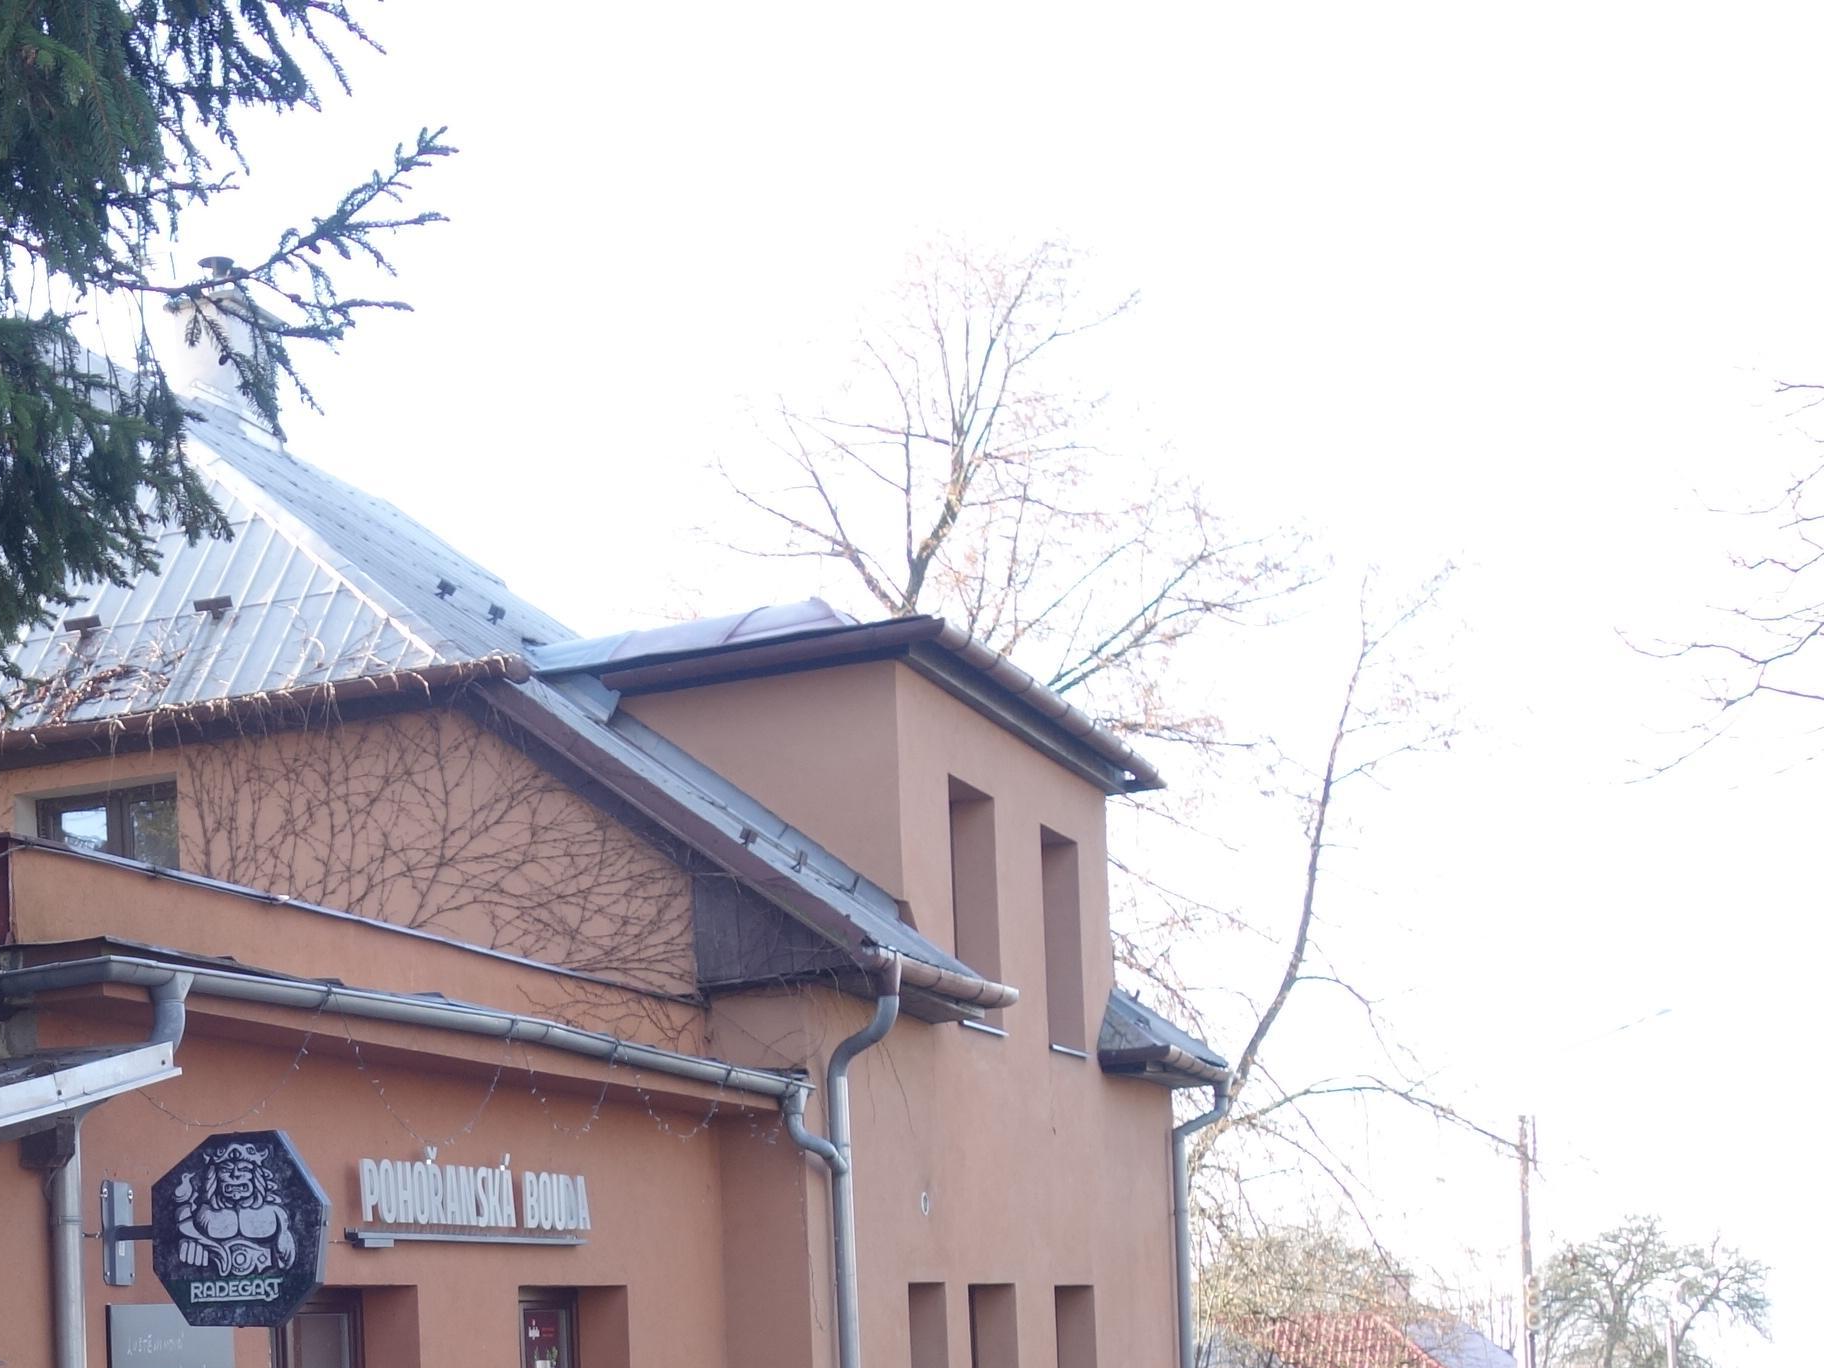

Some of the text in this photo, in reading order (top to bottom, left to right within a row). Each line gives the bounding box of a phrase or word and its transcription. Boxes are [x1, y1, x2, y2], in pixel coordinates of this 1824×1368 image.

[359, 1146, 592, 1230] POHOŘANSKÁ BOUDA
[190, 1277, 283, 1303] RADEGAST
